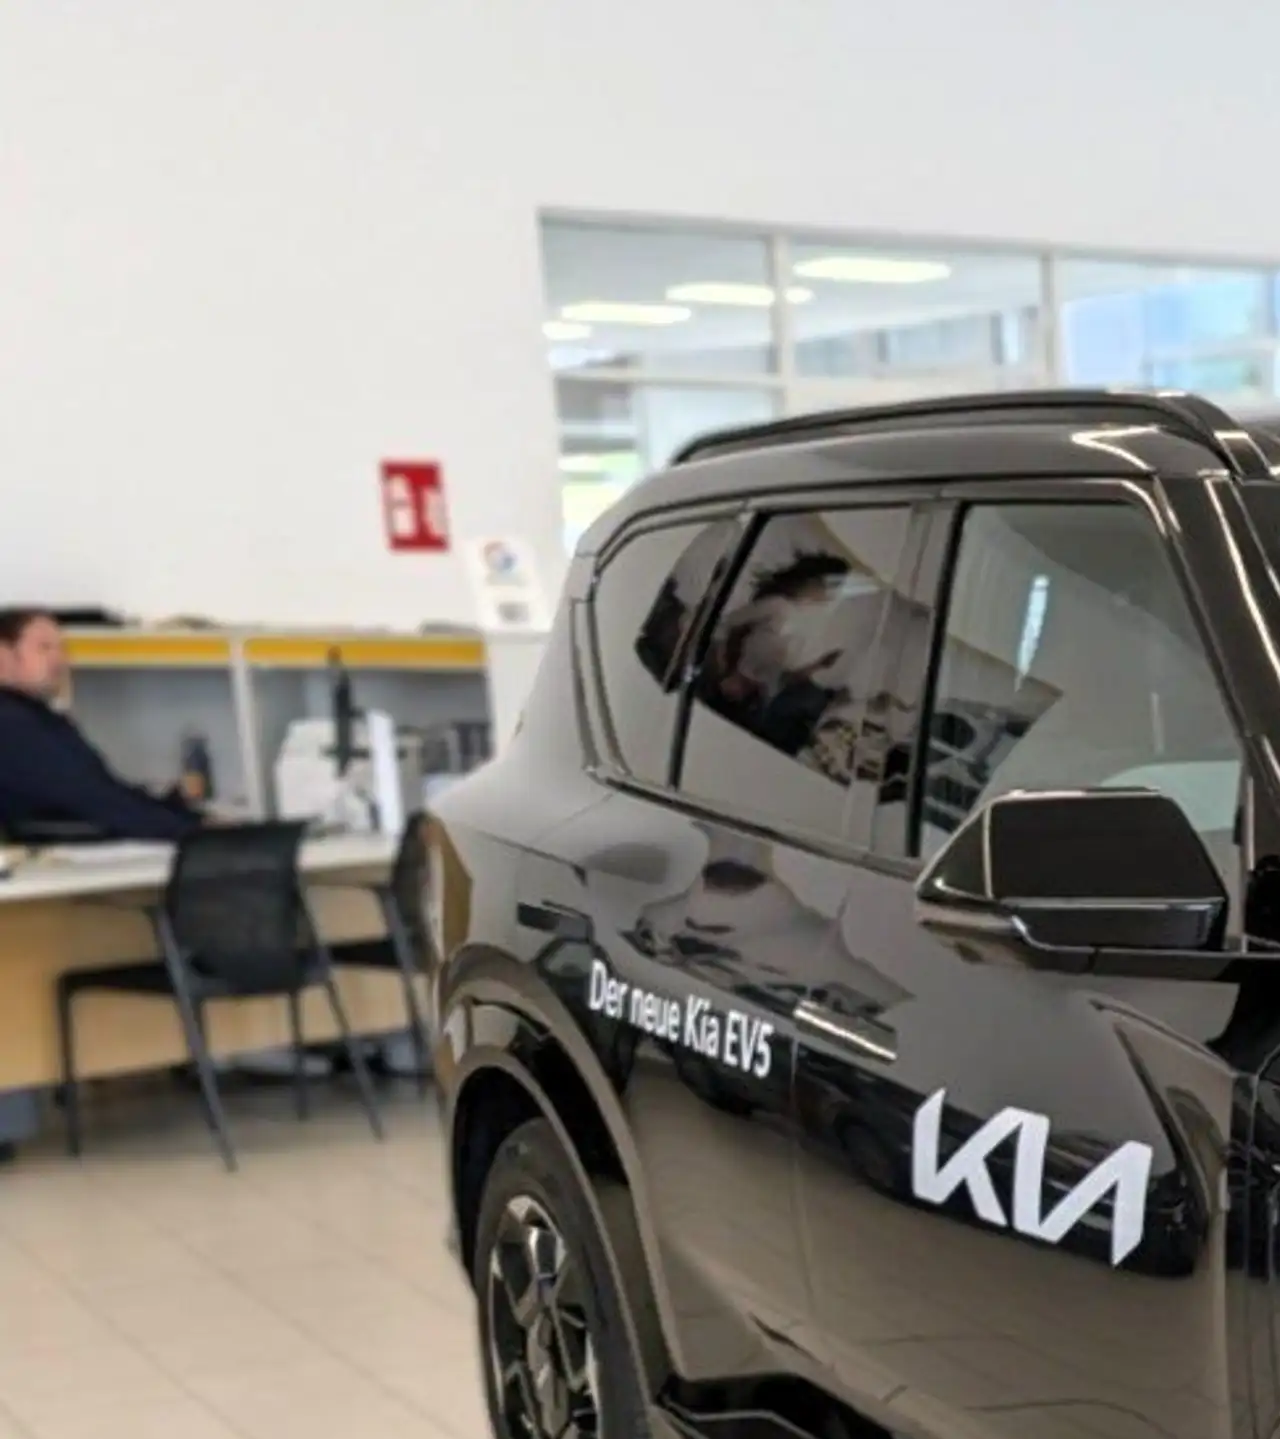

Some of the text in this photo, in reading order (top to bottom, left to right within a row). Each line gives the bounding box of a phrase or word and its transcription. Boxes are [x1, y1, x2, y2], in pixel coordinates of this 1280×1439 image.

[589, 959, 775, 1079] Der neue Kia EV5
[912, 1088, 1153, 1267] KIA
